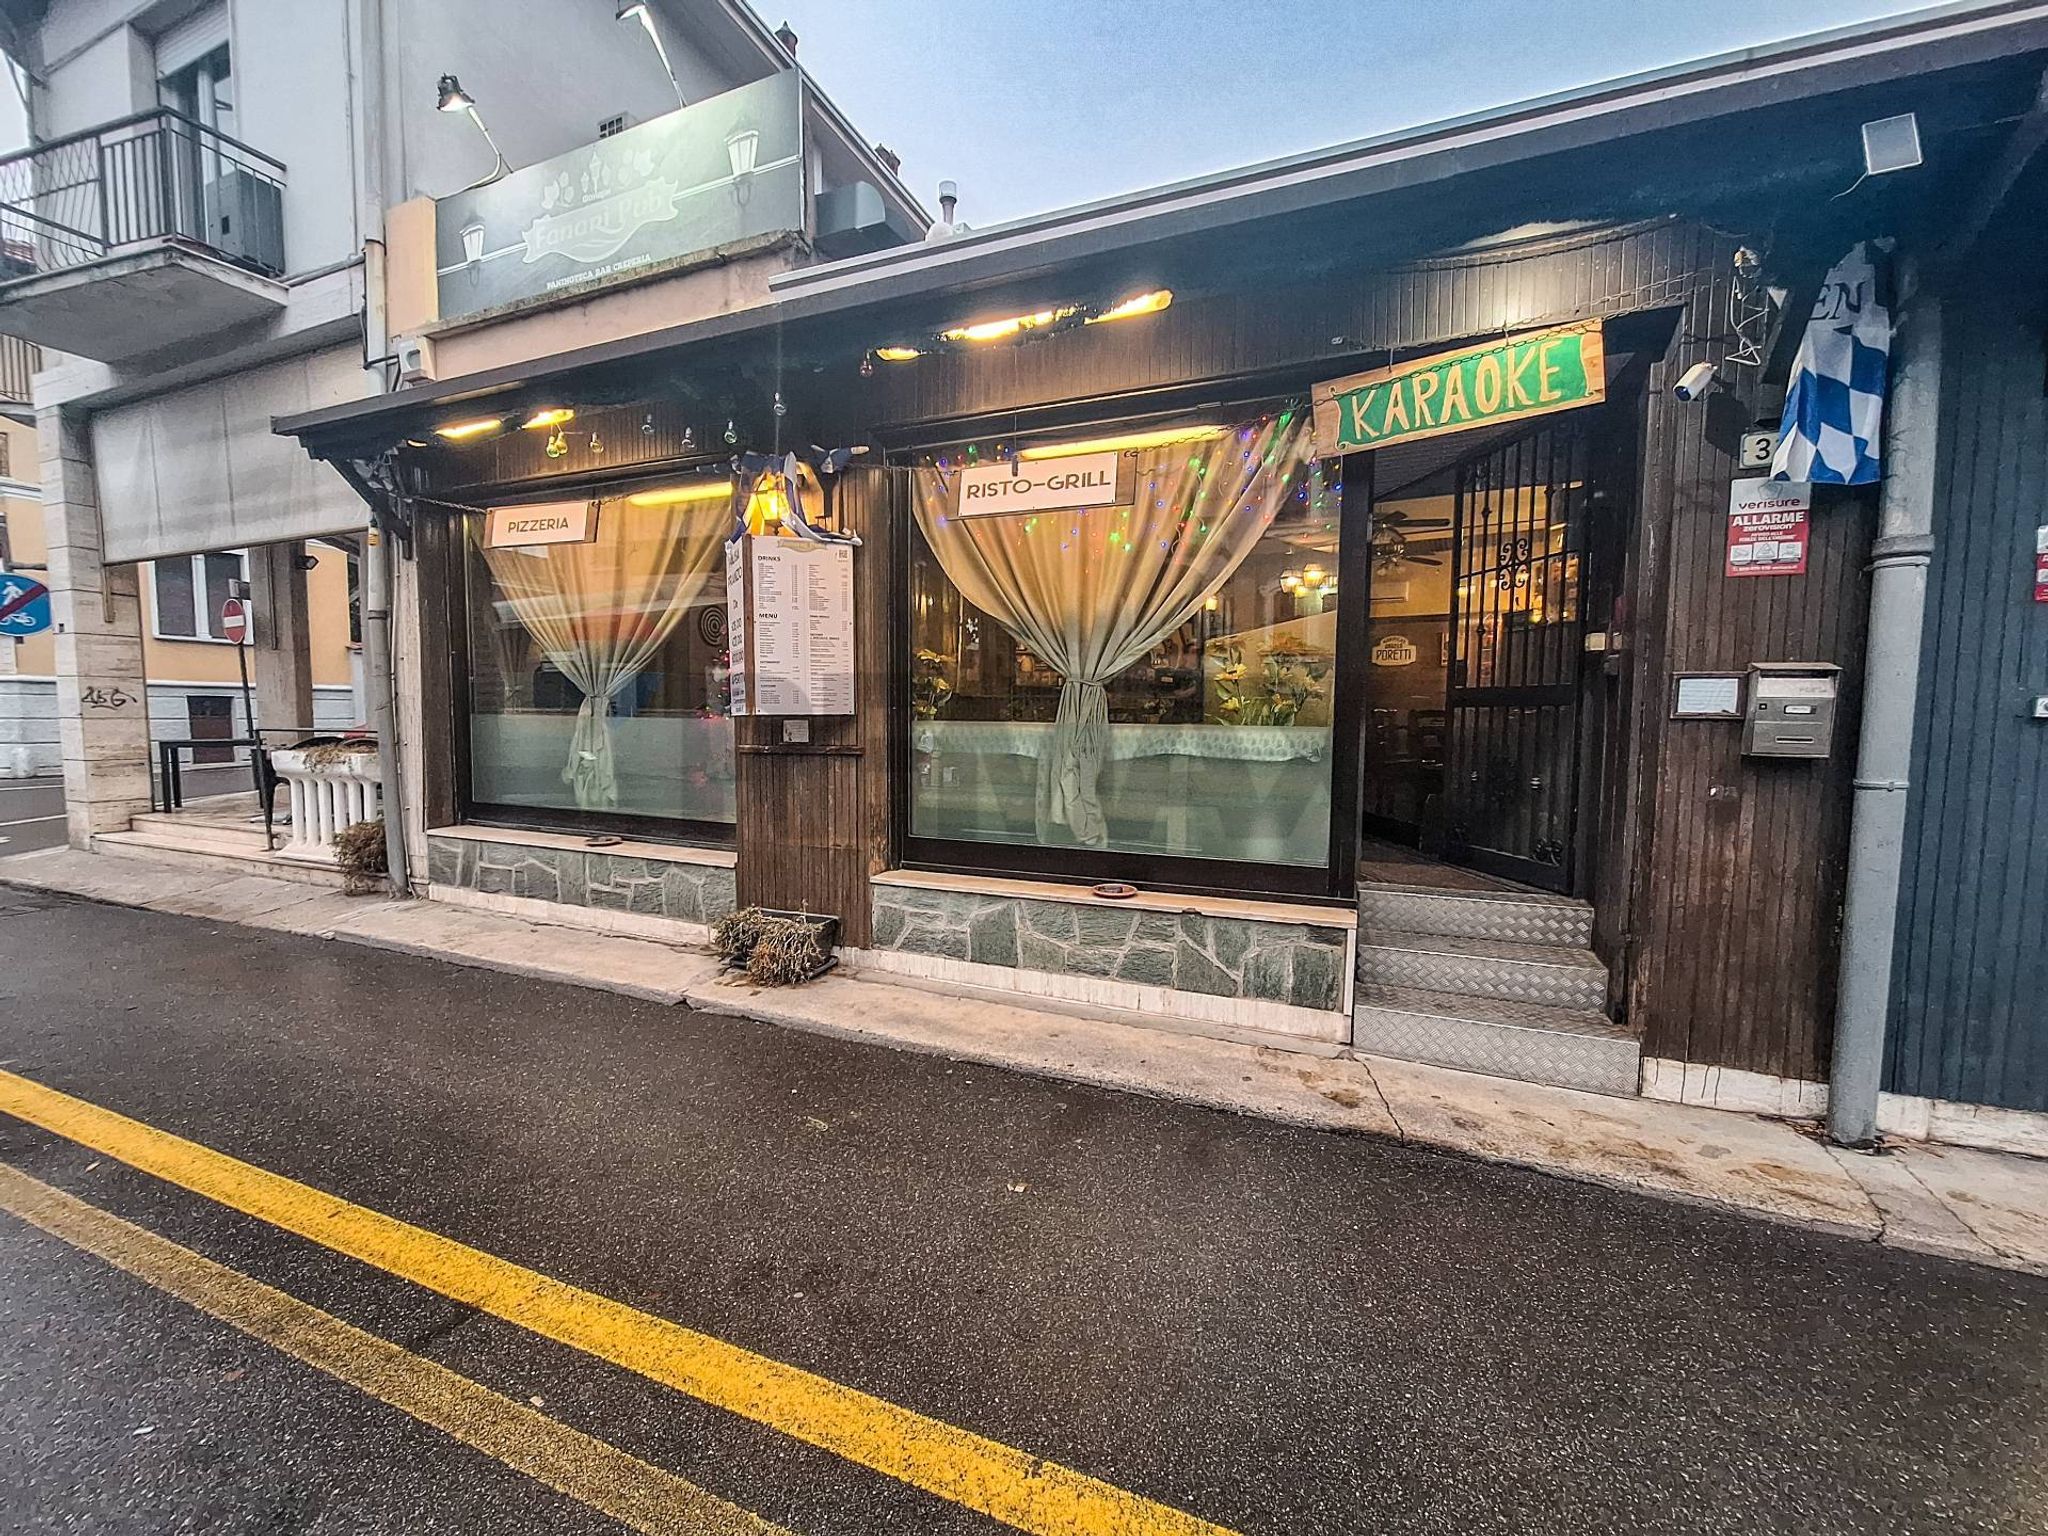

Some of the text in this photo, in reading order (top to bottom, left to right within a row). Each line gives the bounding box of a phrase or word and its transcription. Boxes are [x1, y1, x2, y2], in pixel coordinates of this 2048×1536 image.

[618, 190, 662, 223] Pub
[595, 265, 612, 277] BAR
[613, 254, 651, 271] CREPERIA
[1353, 340, 1563, 440] KARAOKE
[967, 470, 1111, 500] RISTO-GRILL
[1738, 498, 1801, 510] verisure
[508, 517, 569, 533] PIZZERIA
[1732, 511, 1805, 527] ALLARME
[1376, 648, 1412, 661] PORETTI
